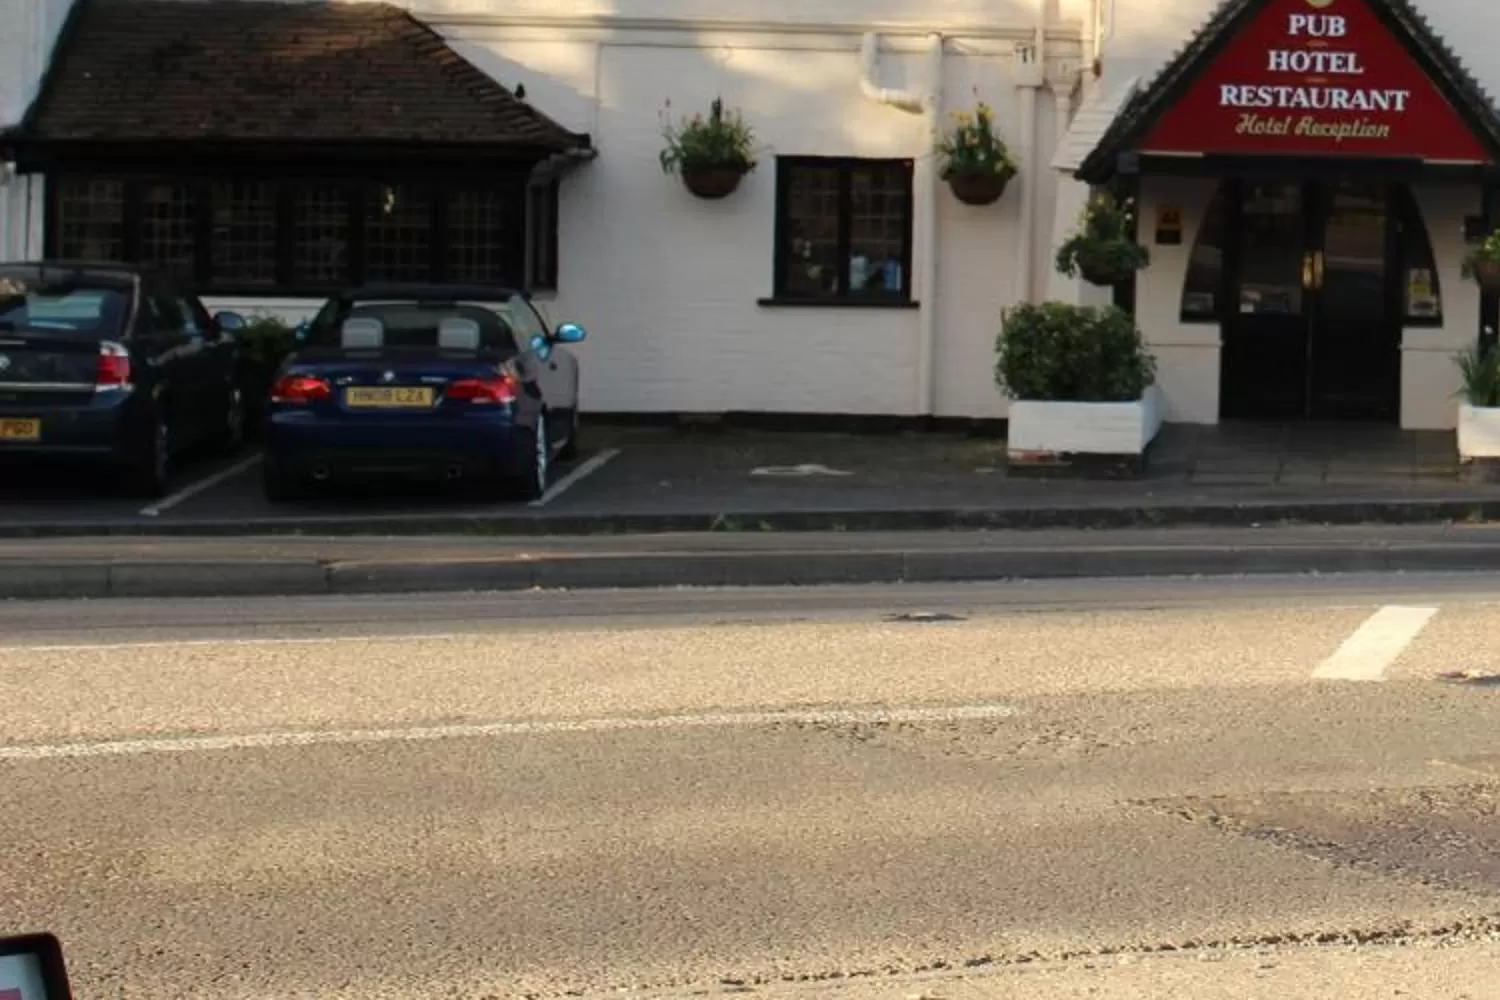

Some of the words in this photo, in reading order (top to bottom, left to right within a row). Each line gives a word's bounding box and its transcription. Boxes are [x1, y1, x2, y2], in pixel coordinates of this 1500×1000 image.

[1288, 13, 1346, 37] PUB
[1267, 49, 1365, 75] HOTEL
[1219, 83, 1410, 112] RESTAURANT
[1235, 113, 1292, 136] Hotel
[1294, 116, 1390, 142] Reception
